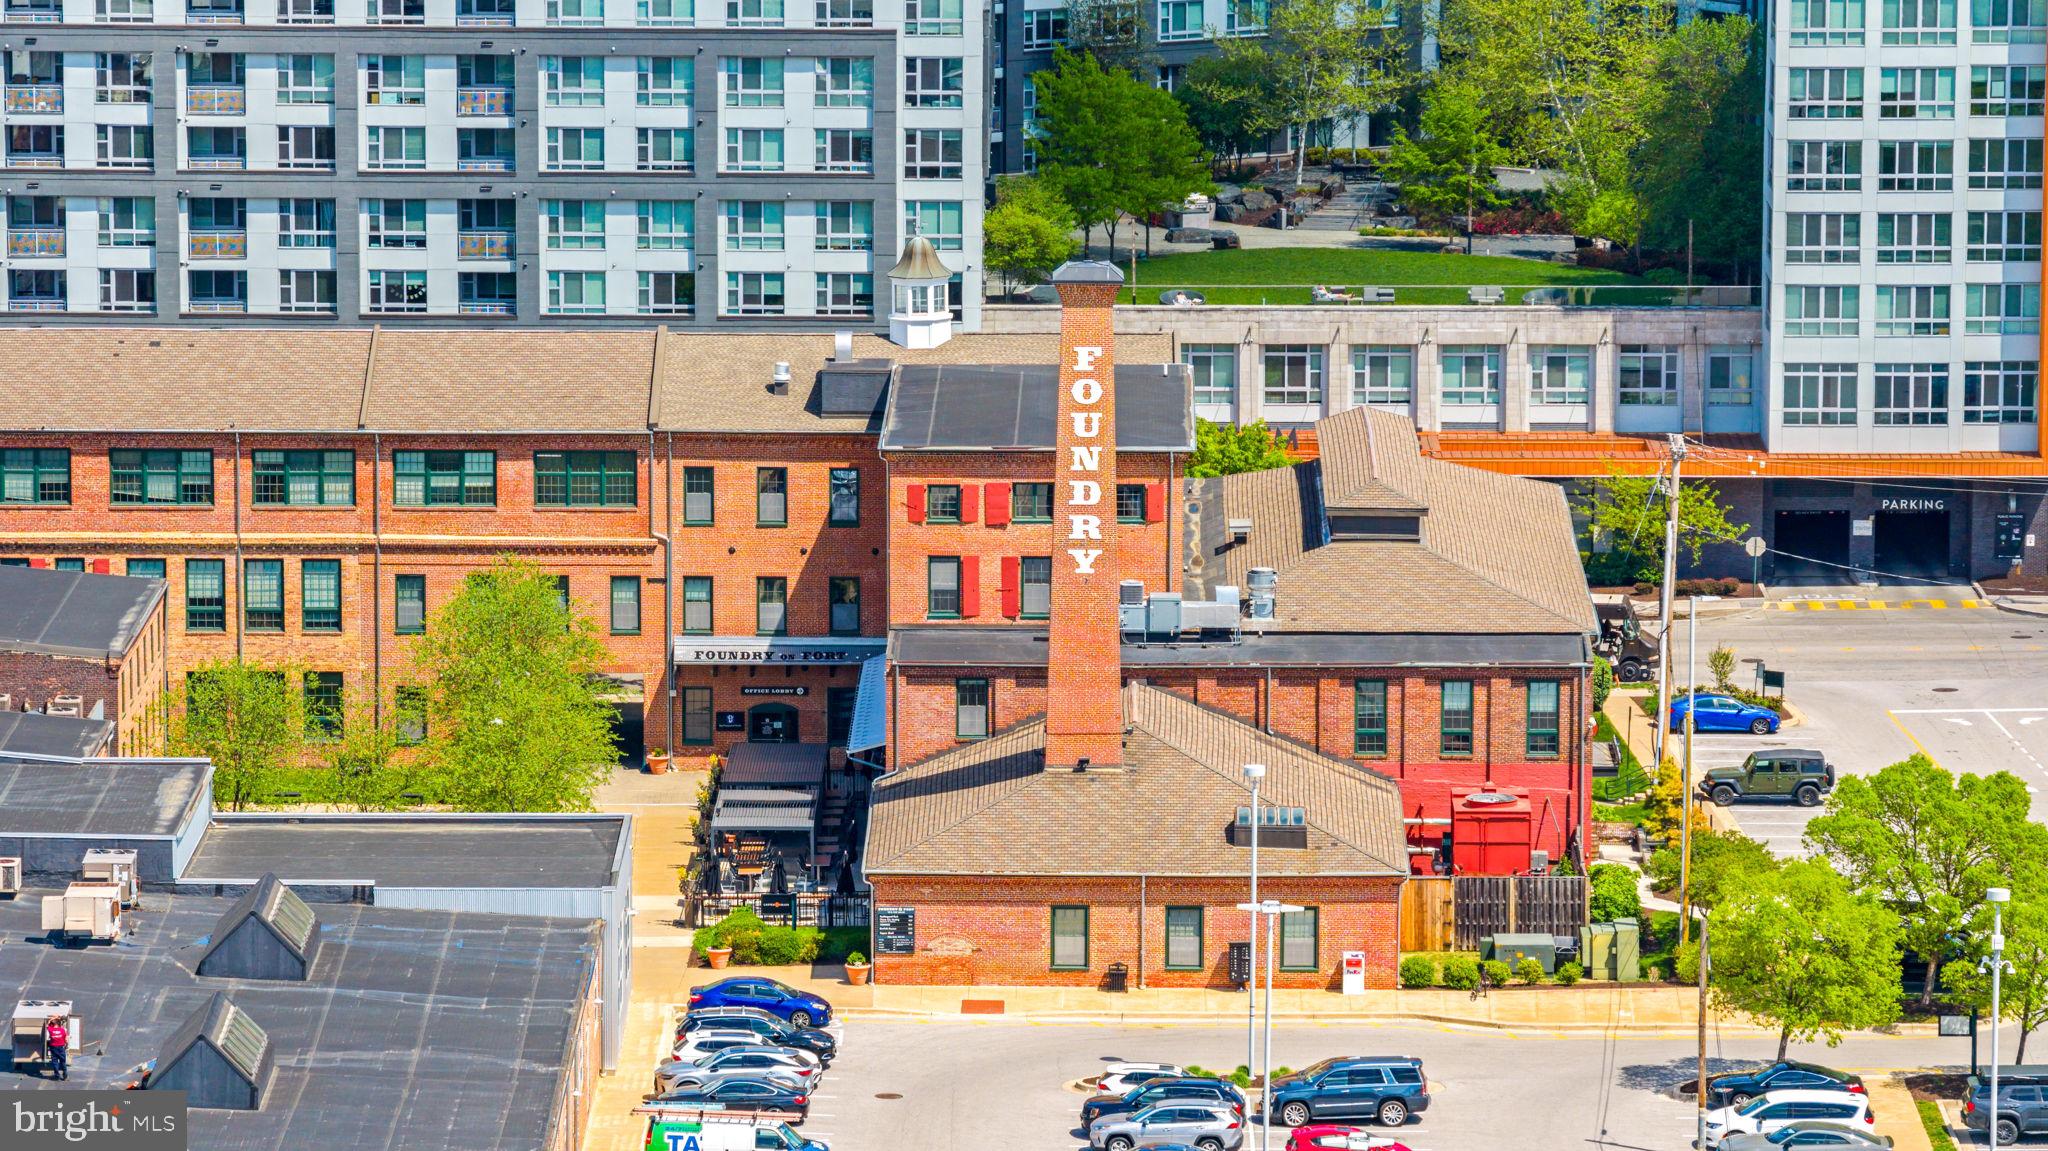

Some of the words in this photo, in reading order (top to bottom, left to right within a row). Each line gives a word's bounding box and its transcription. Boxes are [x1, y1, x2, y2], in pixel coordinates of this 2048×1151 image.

[1067, 346, 1104, 574] FOUNDRY
[1882, 499, 1944, 510] PARKING
[694, 650, 775, 660] FOUNDRY
[802, 651, 846, 660] FORT
